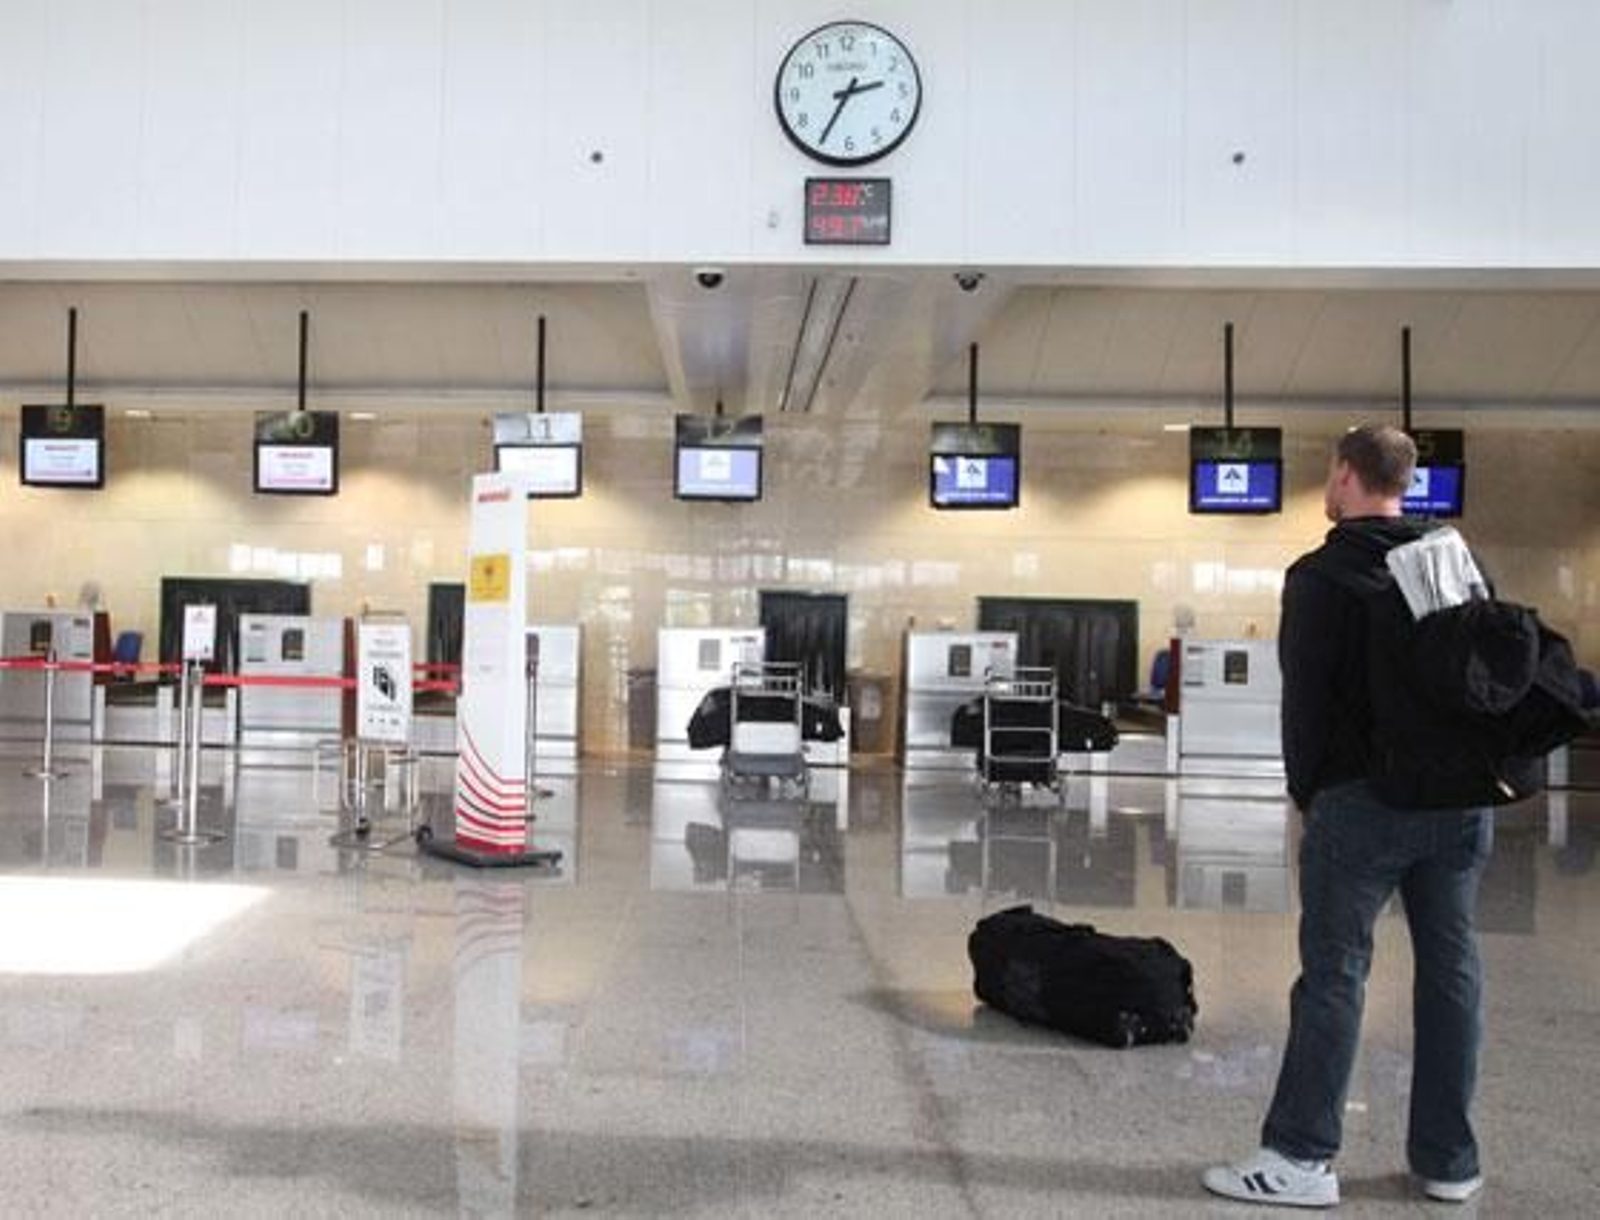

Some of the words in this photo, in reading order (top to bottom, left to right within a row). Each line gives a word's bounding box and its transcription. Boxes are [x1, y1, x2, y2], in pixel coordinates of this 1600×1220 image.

[815, 42, 829, 59] 11
[838, 35, 856, 51] 12
[869, 41, 878, 58] 1
[798, 61, 815, 80] 10
[887, 55, 898, 72] 2
[790, 87, 800, 103] 9
[798, 112, 809, 128] 8
[844, 135, 855, 152] 6
